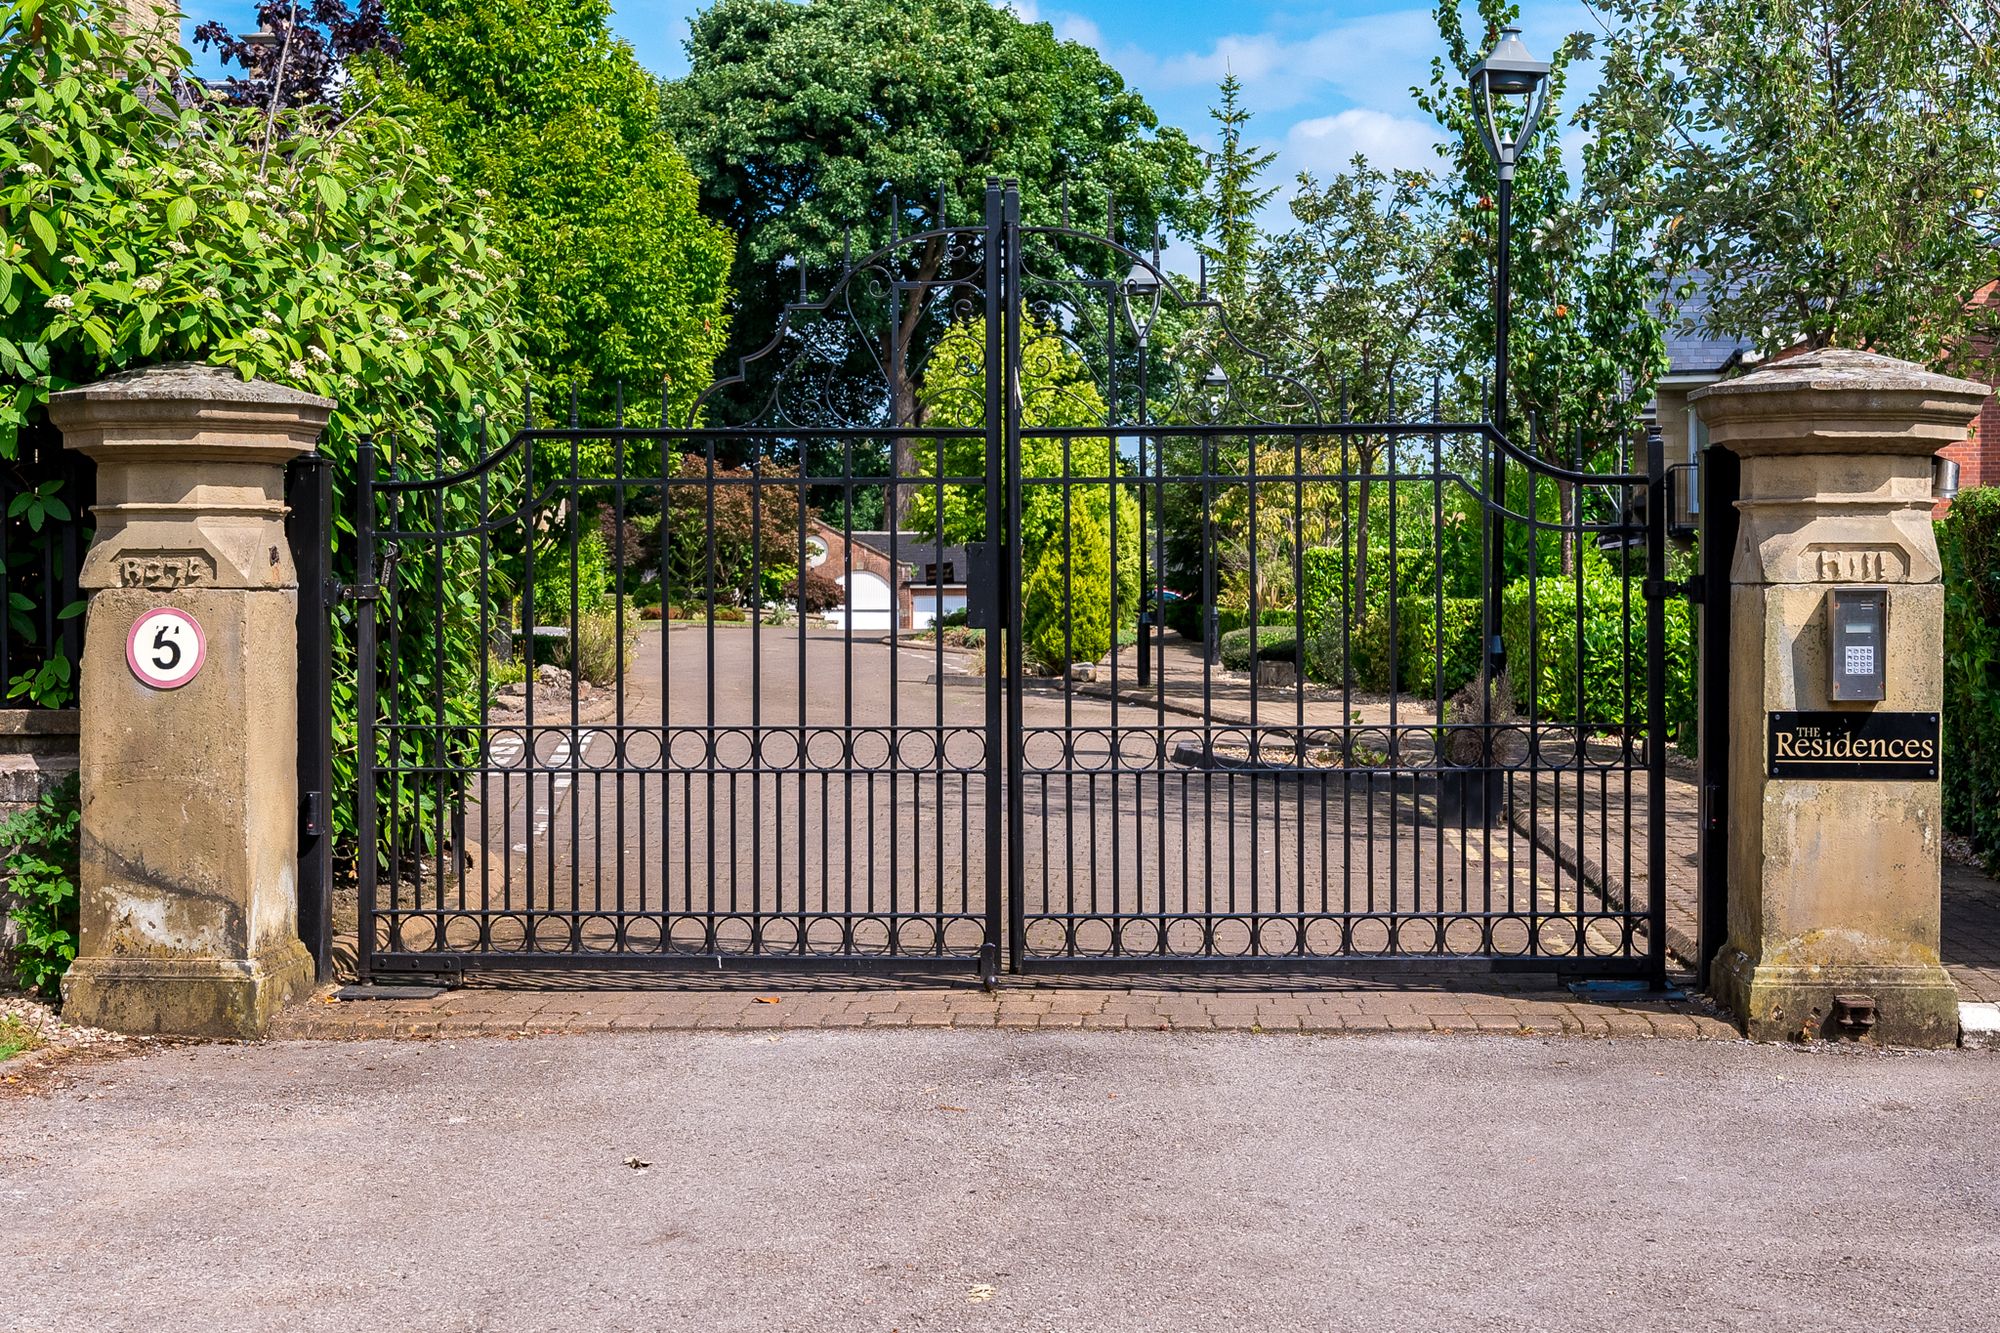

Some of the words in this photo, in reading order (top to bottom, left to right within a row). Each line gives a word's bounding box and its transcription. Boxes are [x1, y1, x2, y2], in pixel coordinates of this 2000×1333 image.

[152, 625, 181, 670] 5
[1775, 731, 1934, 758] Residences
[1796, 727, 1821, 738] THE
